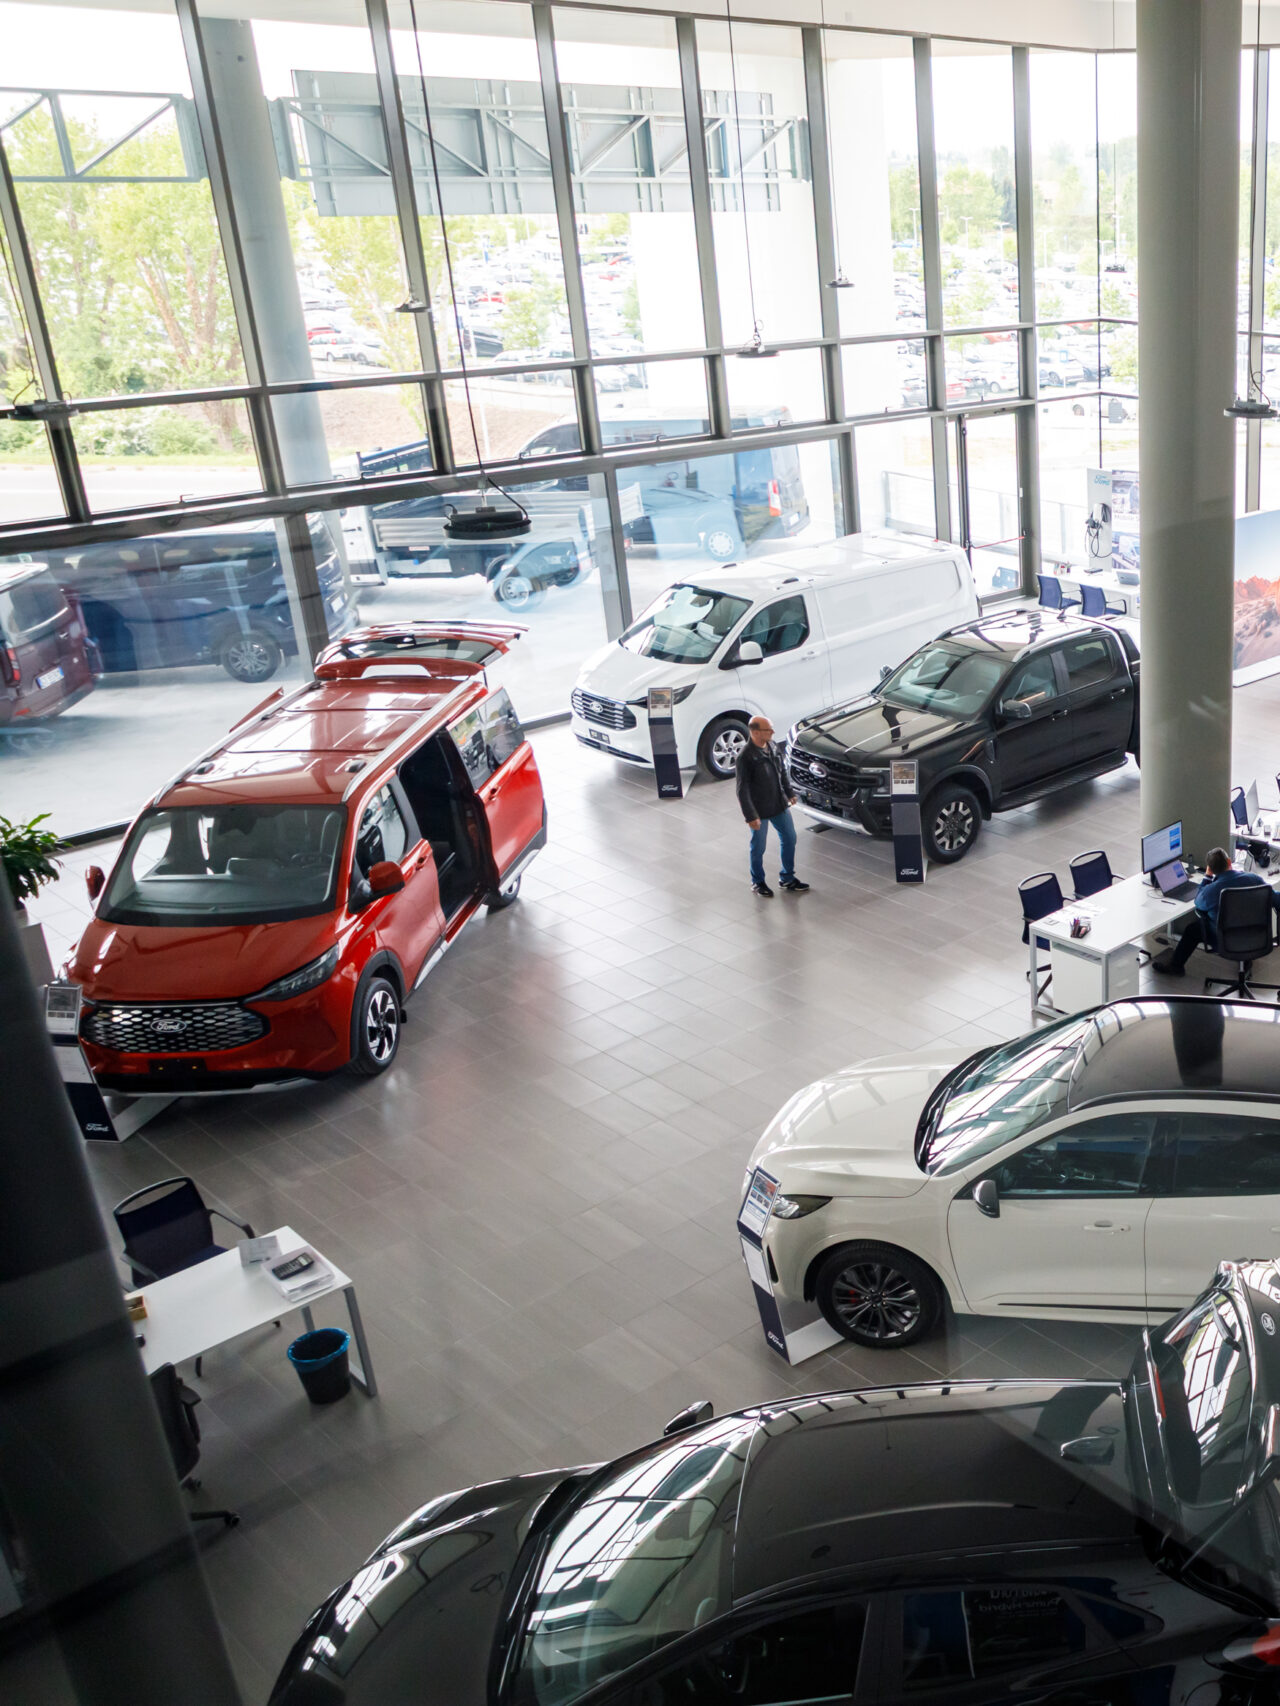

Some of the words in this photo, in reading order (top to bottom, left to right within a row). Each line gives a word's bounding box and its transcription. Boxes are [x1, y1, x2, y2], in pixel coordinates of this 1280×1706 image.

[1093, 475, 1110, 486] Ford
[661, 784, 679, 792] Ford
[900, 868, 919, 876] Ford
[86, 1123, 110, 1133] Ford
[767, 1330, 785, 1350] Ford
